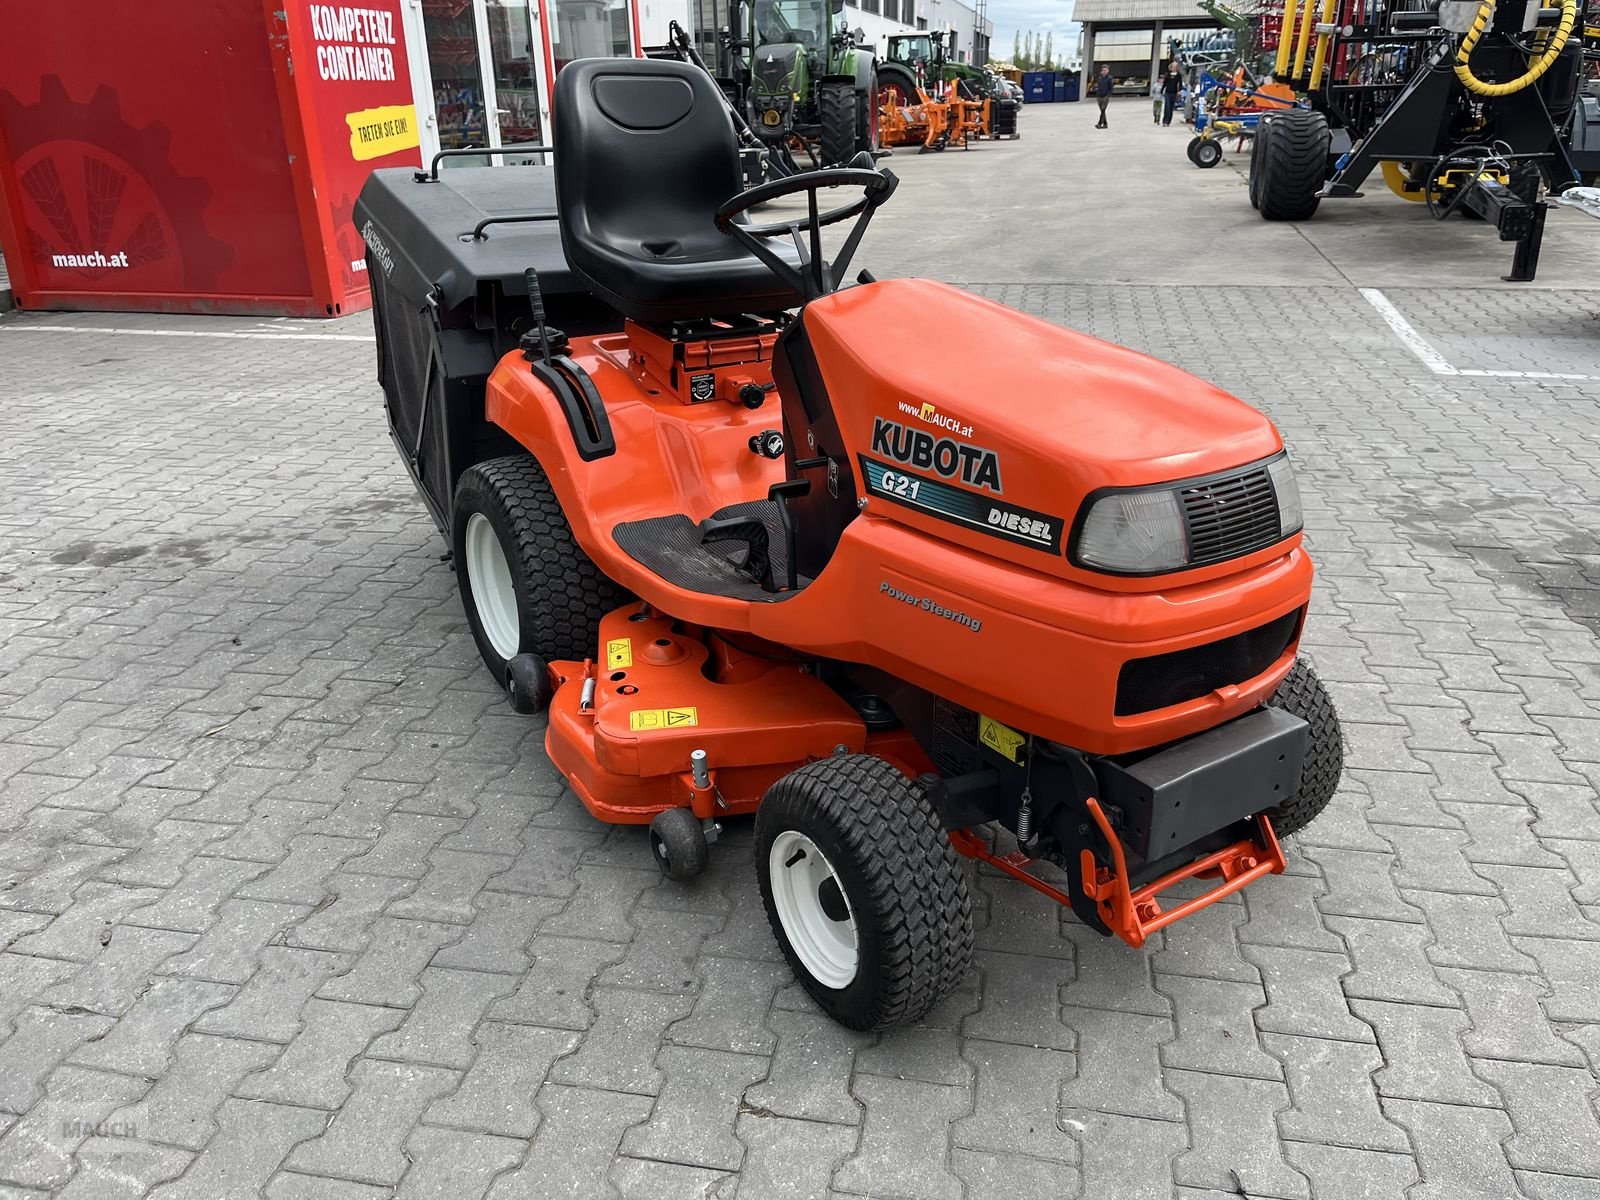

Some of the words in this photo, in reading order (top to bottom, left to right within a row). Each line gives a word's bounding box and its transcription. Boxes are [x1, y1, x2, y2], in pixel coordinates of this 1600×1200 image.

[310, 4, 396, 44] KOMPETENZ
[316, 45, 396, 81] CONTAINER
[358, 123, 384, 143] TRETEN
[383, 120, 395, 137] SIE
[394, 117, 408, 135] EIN!
[52, 250, 129, 267] mauch.at
[898, 401, 974, 438] www.MAUCH.at
[872, 416, 1003, 495] KUBOTA
[881, 471, 921, 500] G21
[988, 508, 1052, 540] DIESEL
